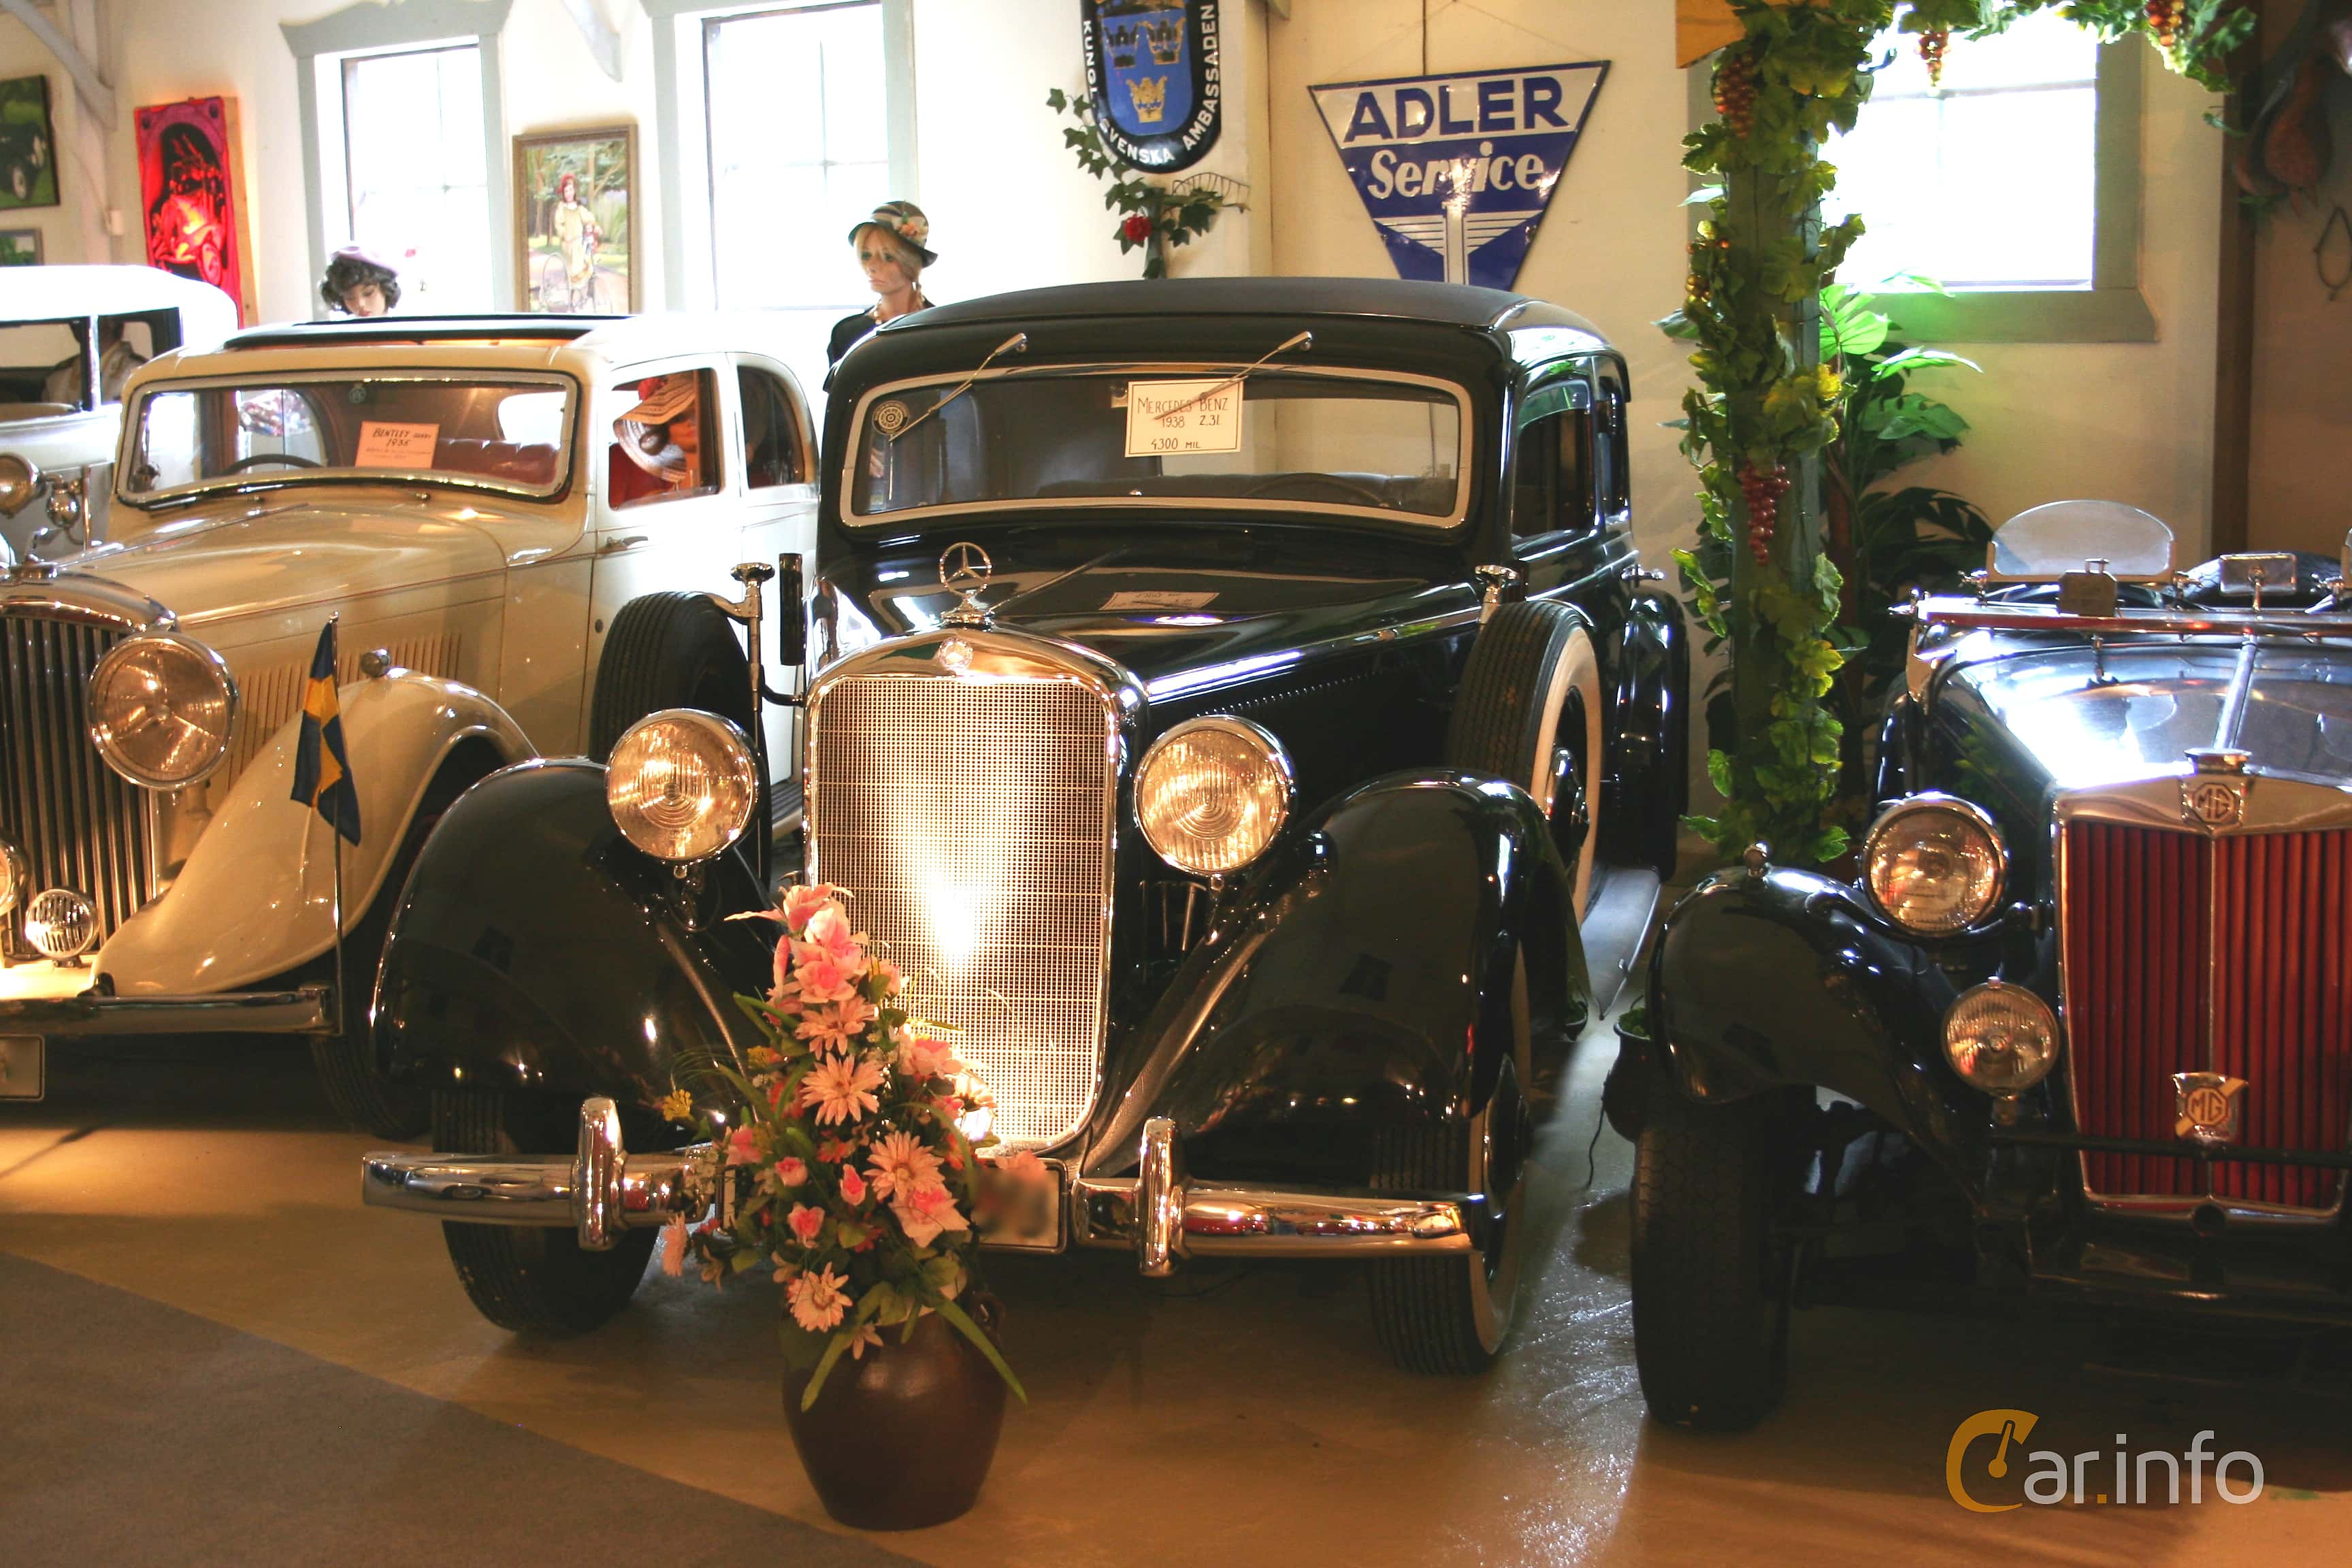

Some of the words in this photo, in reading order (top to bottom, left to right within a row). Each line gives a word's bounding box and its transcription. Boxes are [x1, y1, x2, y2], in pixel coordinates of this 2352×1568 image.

[1099, 118, 1175, 165] SVENSKA
[1181, 4, 1220, 150] AMBASSADEN
[1343, 76, 1571, 143] ADLER
[1367, 141, 1544, 199] Service
[1200, 397, 1229, 412] BENZ
[1162, 415, 1186, 428] 1938
[1151, 438, 1179, 451] 4300
[1185, 441, 1201, 449] MIL
[2197, 787, 2231, 819] MG
[2191, 1091, 2224, 1122] MG
